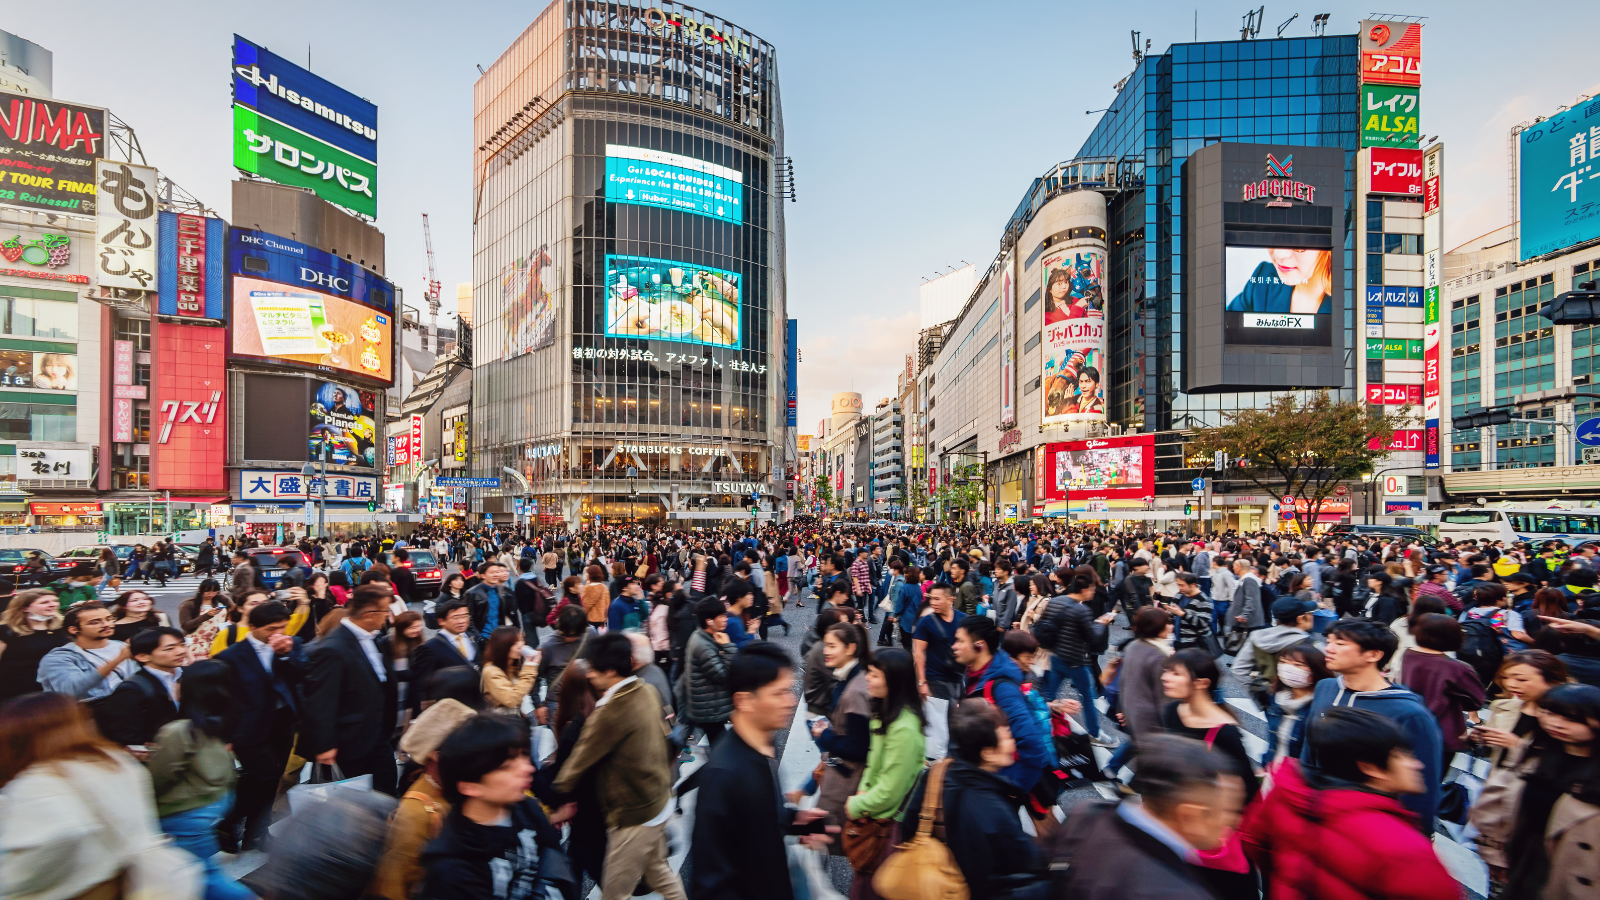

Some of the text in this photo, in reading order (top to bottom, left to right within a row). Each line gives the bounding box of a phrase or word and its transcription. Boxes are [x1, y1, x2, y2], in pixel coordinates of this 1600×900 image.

[1371, 54, 1421, 74] アコム
[235, 65, 377, 141] Hisamitsu
[1367, 92, 1417, 113] レイク
[1364, 114, 1418, 134] ALSA
[243, 128, 373, 198] サロンパス
[1372, 161, 1421, 177] アイフル
[9, 172, 55, 189] TOUR
[627, 165, 643, 175] Get
[644, 167, 677, 180] LOCAL
[677, 174, 714, 189] GUIDES
[609, 173, 739, 205] Experience the REAL SHIBUYA
[1243, 179, 1316, 205] MAGNET
[1408, 184, 1422, 194] 8F
[19, 192, 80, 209] Release!!
[671, 196, 696, 209] Japan
[99, 164, 154, 288] もんじゃ
[241, 234, 304, 255] DHC Channel
[177, 216, 200, 312] 三千里薬品
[299, 266, 349, 292] DHC
[1367, 291, 1419, 304] レオパレス21
[1256, 317, 1302, 328] みんなのFX
[1366, 343, 1383, 351] レイク
[1427, 358, 1438, 382] アコム
[1370, 388, 1406, 400] アコム
[157, 390, 223, 444] クスリ
[324, 415, 364, 431] Planets
[330, 410, 354, 421] teamLab
[413, 419, 421, 453] カラオケ
[1085, 440, 1109, 449] Glico
[1428, 426, 1437, 456] PROMISE
[617, 444, 726, 457] STARBUCKS COFFEE
[30, 460, 72, 476] 松川
[714, 482, 767, 494] TSUTAYA
[1386, 476, 1403, 493] 0円
